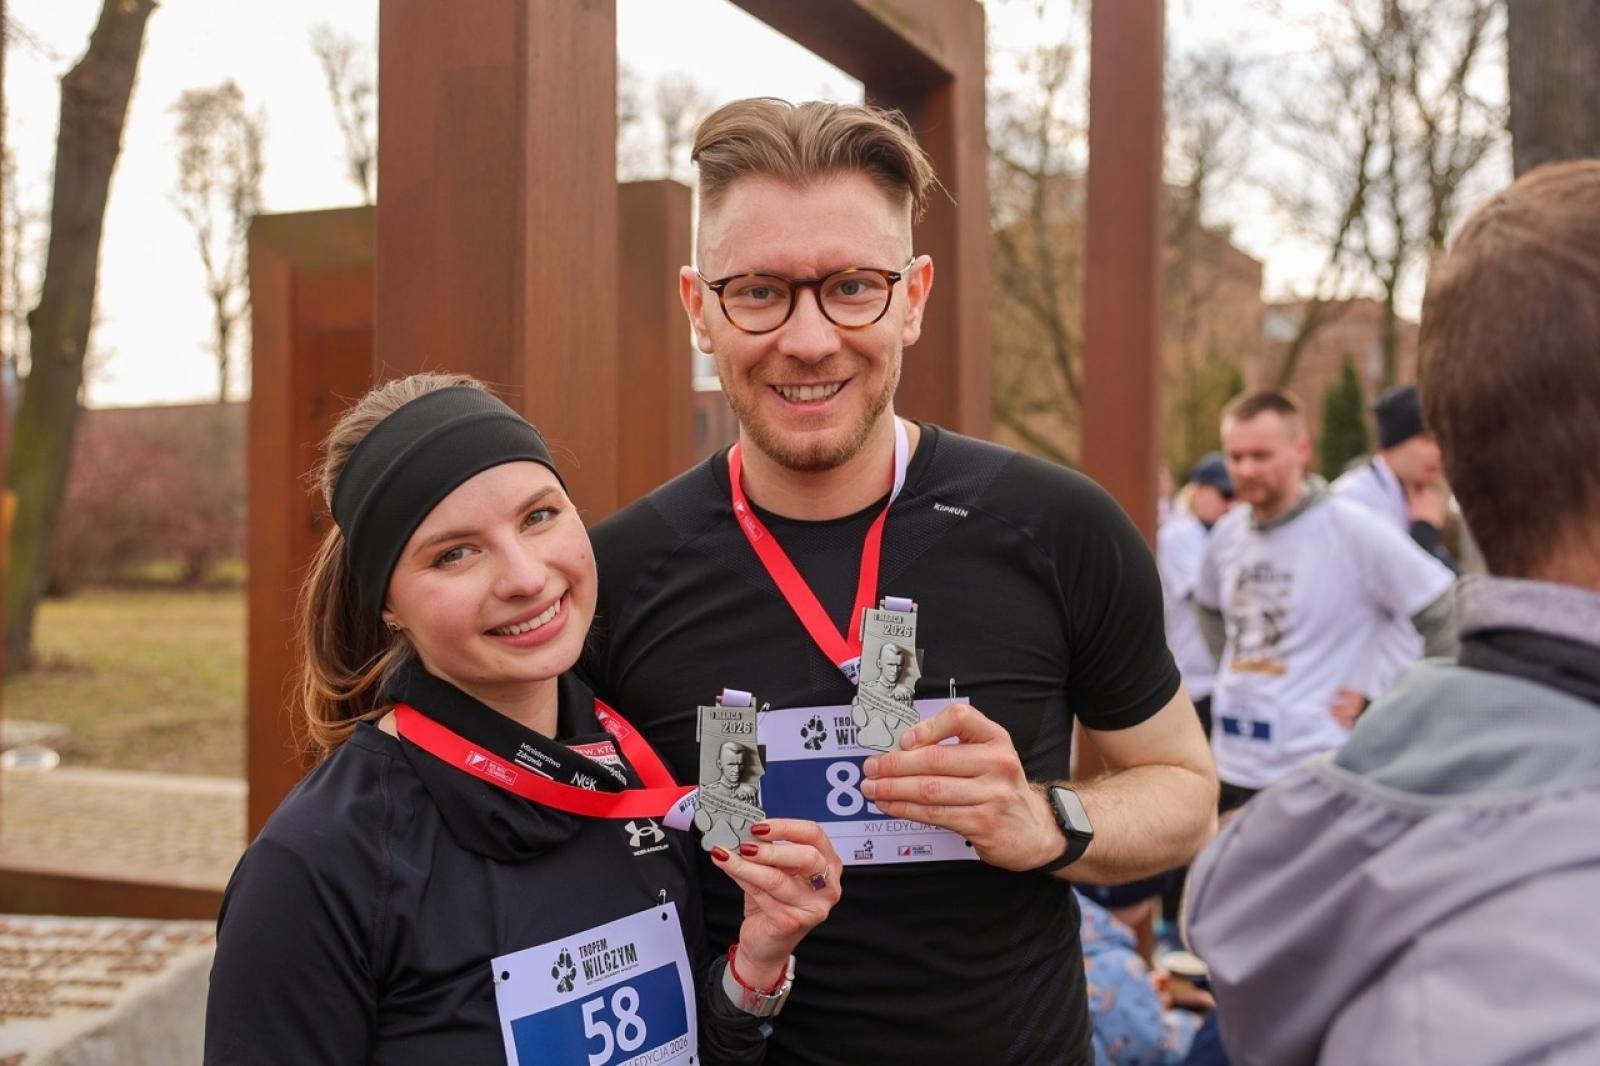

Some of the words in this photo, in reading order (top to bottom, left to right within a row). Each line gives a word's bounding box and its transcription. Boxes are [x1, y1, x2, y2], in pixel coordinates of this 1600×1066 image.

[933, 502, 969, 518] KIPRUN
[883, 623, 912, 638] 2026
[721, 720, 752, 735] 2026
[515, 749, 543, 768] Zdrowia
[519, 742, 561, 768] Ministerstwo
[825, 760, 885, 816] 8
[863, 822, 883, 833] XIV
[578, 937, 607, 959] TROPEM
[582, 942, 638, 981] WILCZYM
[581, 986, 647, 1066] 58
[669, 1036, 688, 1054] 2026
